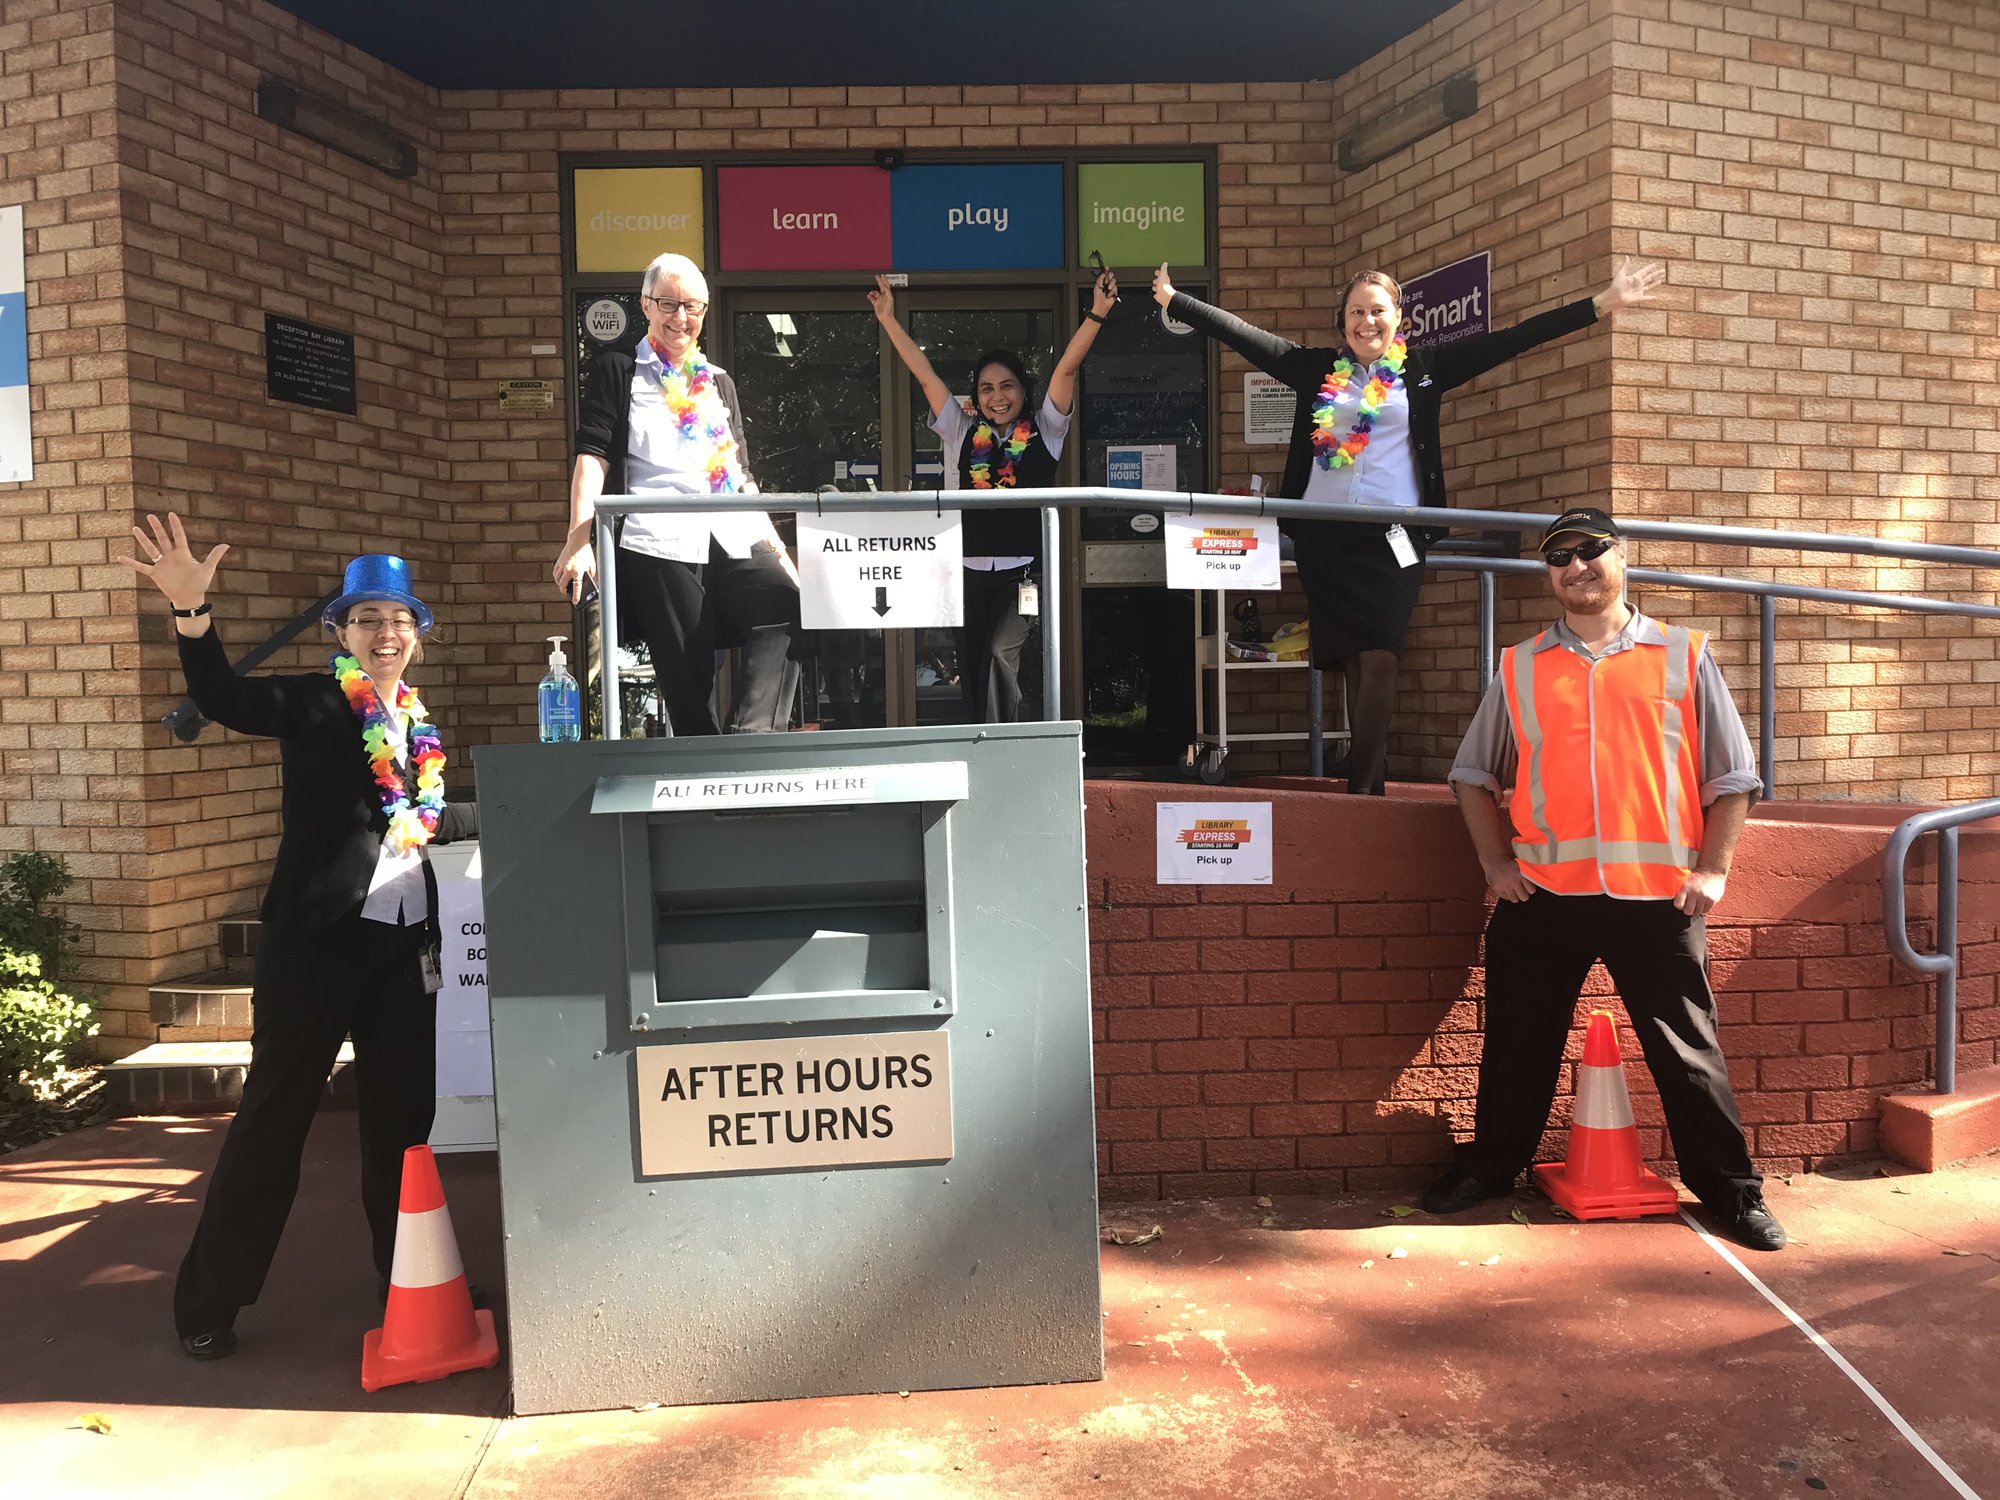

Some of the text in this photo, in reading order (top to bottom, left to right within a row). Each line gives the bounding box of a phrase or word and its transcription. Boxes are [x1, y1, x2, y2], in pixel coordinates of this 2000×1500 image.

[590, 210, 690, 231] discover
[773, 208, 838, 230] learn
[948, 203, 1009, 232] play
[1093, 201, 1185, 230] imagine
[1412, 290, 1423, 301] are
[1400, 286, 1482, 340] eSmart
[592, 320, 620, 330] WiFi
[276, 323, 345, 346] DECEPTION BAY LIBRARY
[1109, 462, 1141, 471] OPENING
[1110, 471, 1141, 481] HOURS
[823, 536, 936, 552] ALL RETURNS
[1202, 539, 1244, 548] EXPRESS
[859, 566, 902, 580] HERE
[1206, 561, 1241, 571] Pick up
[703, 781, 804, 796] RETURNS
[816, 777, 870, 791] HERE
[1201, 821, 1234, 829] LIBRARY
[1193, 832, 1236, 841] EXPRESS
[1196, 855, 1232, 866] Pick up
[661, 1054, 932, 1102] AFTER HOURS
[708, 1104, 894, 1148] RETURNS
